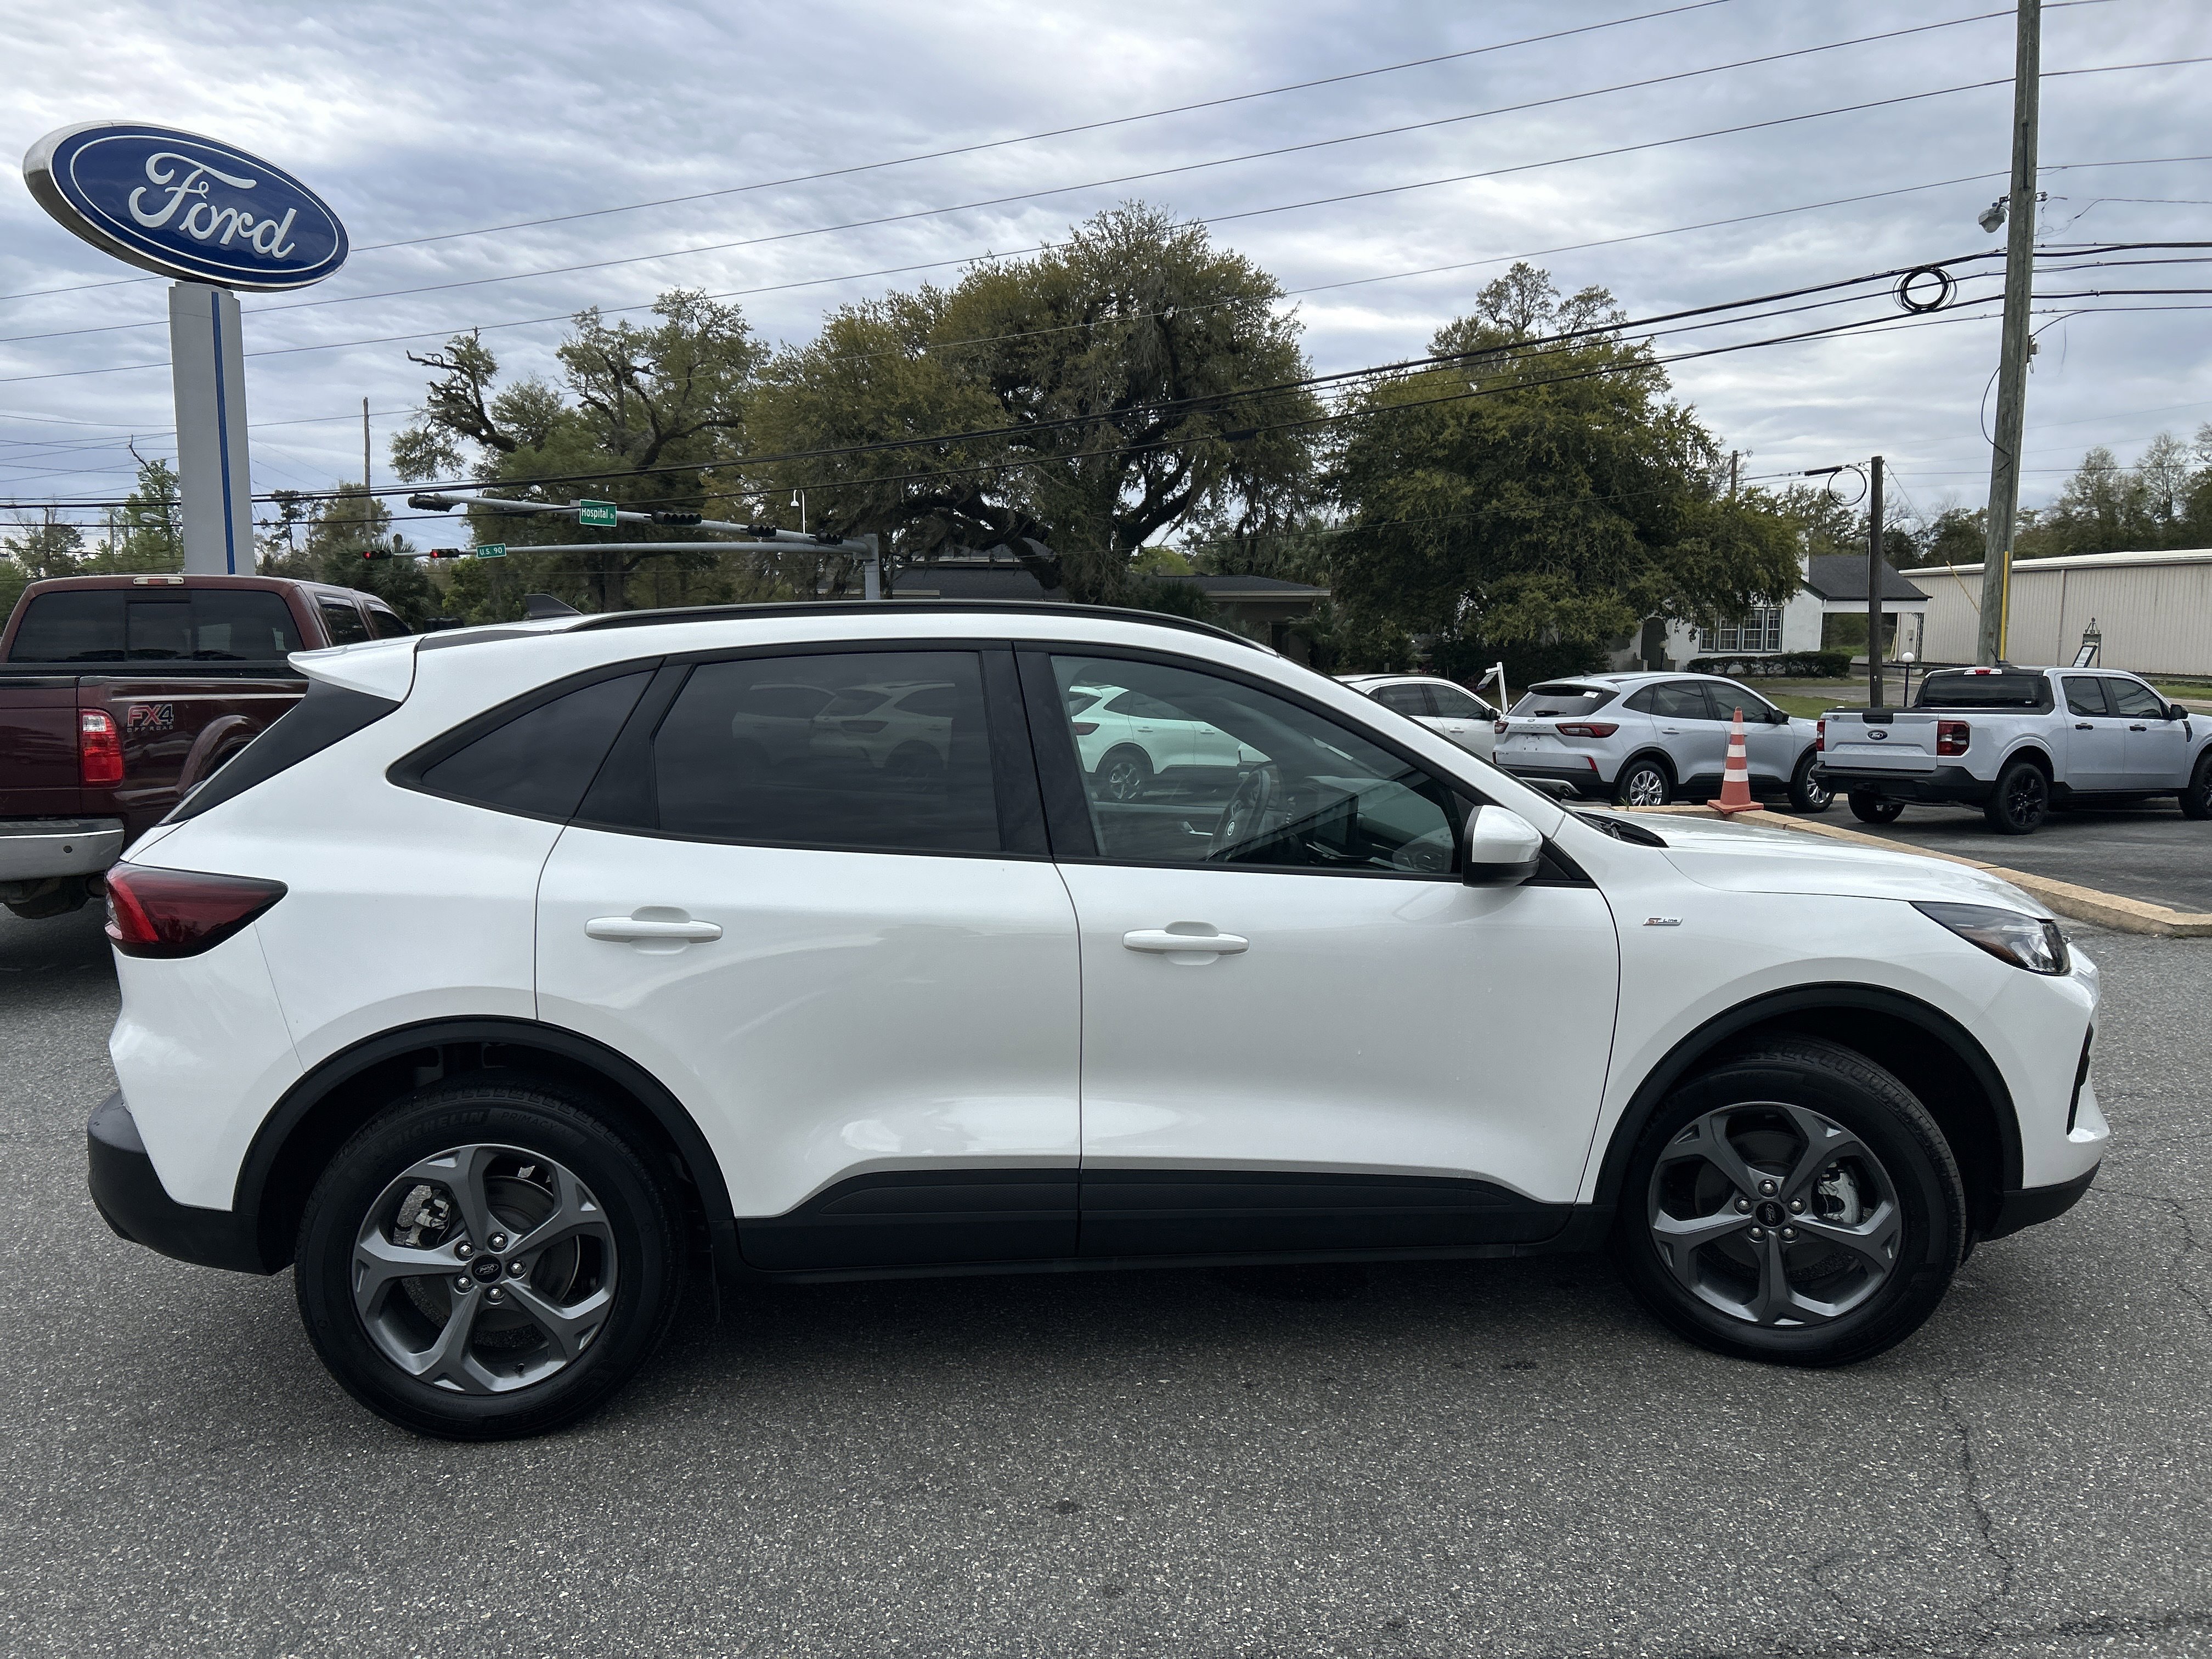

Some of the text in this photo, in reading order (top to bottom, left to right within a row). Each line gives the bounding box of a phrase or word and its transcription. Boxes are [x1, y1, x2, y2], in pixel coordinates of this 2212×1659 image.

[129, 153, 295, 258] Ford
[582, 508, 608, 520] Hospital
[127, 703, 174, 727] FX4
